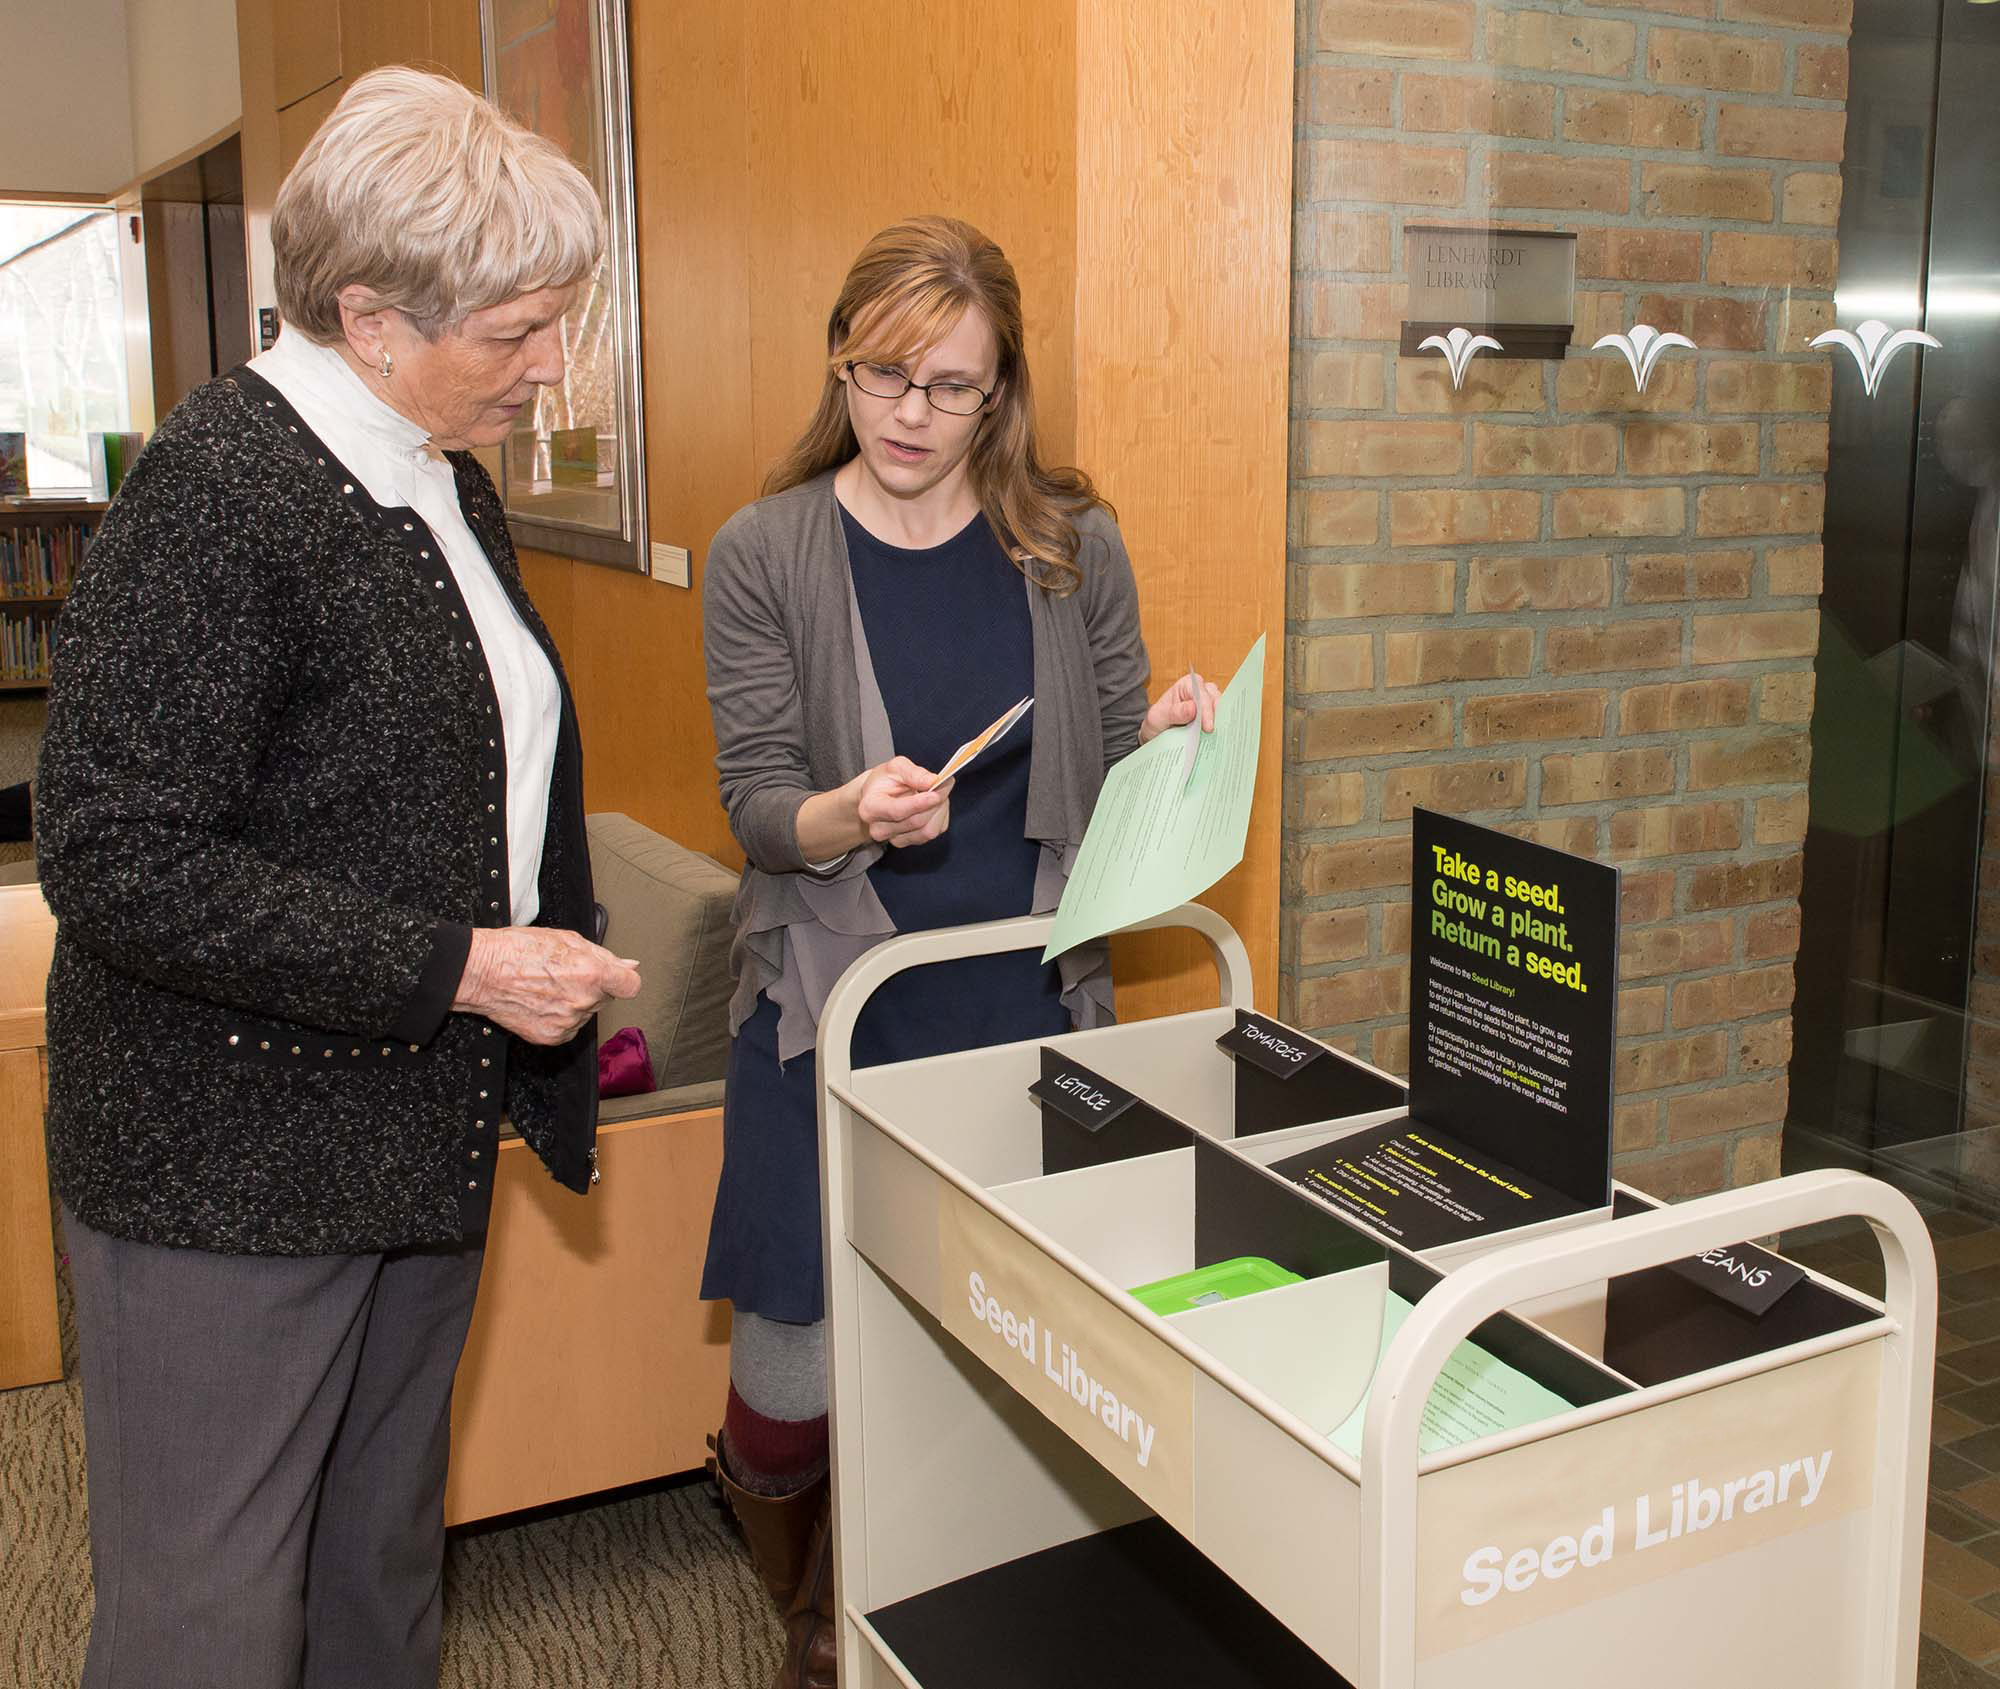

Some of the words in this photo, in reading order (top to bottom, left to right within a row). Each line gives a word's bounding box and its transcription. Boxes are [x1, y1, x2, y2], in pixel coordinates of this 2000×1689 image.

[1426, 271, 1501, 290] LIBRARY
[1427, 245, 1526, 266] LENHARDT
[1432, 845, 1480, 885] Take
[1486, 869, 1498, 892] a
[1504, 876, 1564, 914] seed.
[1432, 879, 1486, 920] Grow
[1492, 906, 1504, 928] a
[1511, 910, 1572, 952] plant.
[1429, 956, 1454, 973] Welcome
[1455, 966, 1461, 975] to
[1462, 969, 1471, 979] the
[1472, 972, 1488, 986] Seed
[1490, 979, 1515, 997] Library!
[1432, 910, 1500, 960] Return
[1507, 944, 1519, 967] a
[1526, 952, 1587, 992] seed.
[1429, 978, 1442, 990] Here
[1442, 986, 1452, 994] you
[1454, 990, 1464, 999] can
[1490, 1005, 1506, 1017] seeds
[1508, 1011, 1514, 1020] to
[1515, 1015, 1530, 1027] plant,
[1532, 1021, 1538, 1030] to
[1540, 1025, 1556, 1038] grow,
[1557, 1032, 1569, 1042] and
[1429, 990, 1435, 998] to
[1436, 994, 1451, 1006] enjoy!
[1452, 999, 1472, 1014] Harvest
[1474, 1009, 1482, 1018] the
[1484, 1014, 1500, 1026] seeds
[1501, 1020, 1514, 1032] from
[1516, 1026, 1525, 1036] the
[1526, 1032, 1544, 1044] plants
[1545, 1039, 1556, 1049] you
[1557, 1045, 1573, 1056] grow
[1429, 1002, 1439, 1011] and
[1440, 1007, 1455, 1018] return
[1457, 1014, 1471, 1025] some
[1481, 1024, 1498, 1037] others
[1500, 1031, 1506, 1040] to
[1533, 1046, 1545, 1057] next
[1242, 1024, 1306, 1064] TOMATOES
[1429, 1022, 1436, 1033] By
[1437, 1027, 1468, 1048] participating
[1470, 1040, 1474, 1048] in
[1480, 1045, 1495, 1058] Seed
[1496, 1052, 1516, 1068] Library,
[1517, 1062, 1528, 1072] you
[1529, 1066, 1553, 1083] become
[1554, 1079, 1566, 1090] part
[1435, 1036, 1443, 1046] the
[1444, 1042, 1464, 1058] growing
[1466, 1052, 1495, 1071] community
[1496, 1064, 1501, 1072] of
[1543, 1086, 1554, 1096] and
[1054, 1072, 1112, 1112] LETTUCE
[1428, 1043, 1445, 1058] keeper
[1453, 1056, 1471, 1070] shared
[1472, 1064, 1502, 1084] knowledge
[1512, 1082, 1521, 1093] the
[1522, 1088, 1534, 1099] next
[1536, 1095, 1567, 1114] generation
[1428, 1144, 1456, 1160] welcome
[1463, 1163, 1477, 1171] use
[1476, 1169, 1489, 1177] the
[1488, 1176, 1509, 1187] Seed
[968, 1272, 1036, 1365] Seed
[1044, 1328, 1155, 1467] Library
[1460, 1506, 1615, 1606] Seed
[1635, 1450, 1832, 1550] Library
